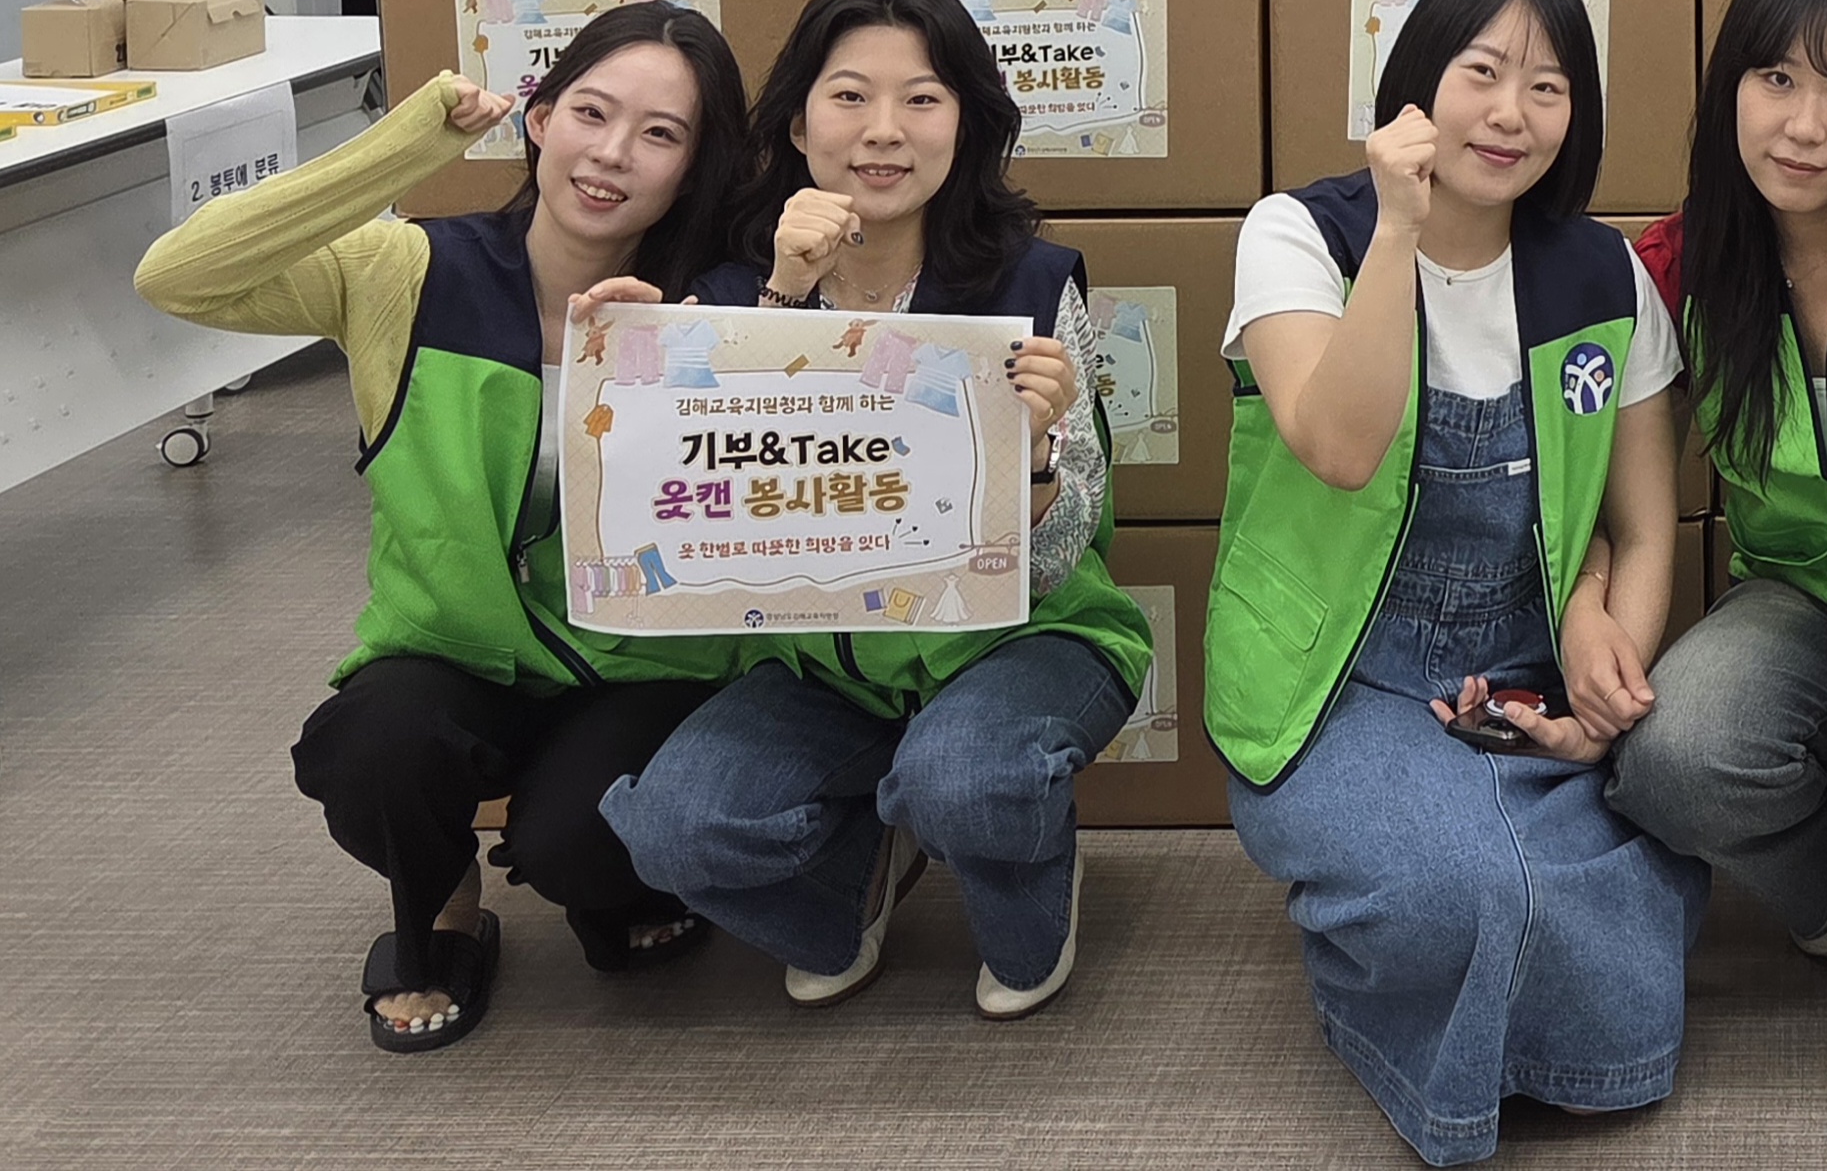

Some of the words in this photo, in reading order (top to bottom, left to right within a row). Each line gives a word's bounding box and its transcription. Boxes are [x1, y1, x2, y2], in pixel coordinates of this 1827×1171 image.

[1013, 66, 1105, 92] 봉사활동
[210, 162, 248, 197] 봉투에
[675, 396, 813, 416] 김해교육지원청과
[818, 394, 854, 413] 함께
[859, 393, 895, 411] 하는
[682, 431, 890, 470] 기부&Take
[653, 478, 732, 521] 옷캔
[744, 471, 909, 518] 봉사활동
[678, 542, 695, 559] 옷
[699, 540, 748, 558] 한벌로
[752, 538, 800, 556] 따뜻한
[805, 535, 854, 553] 희망을
[976, 557, 1008, 570] OPEN
